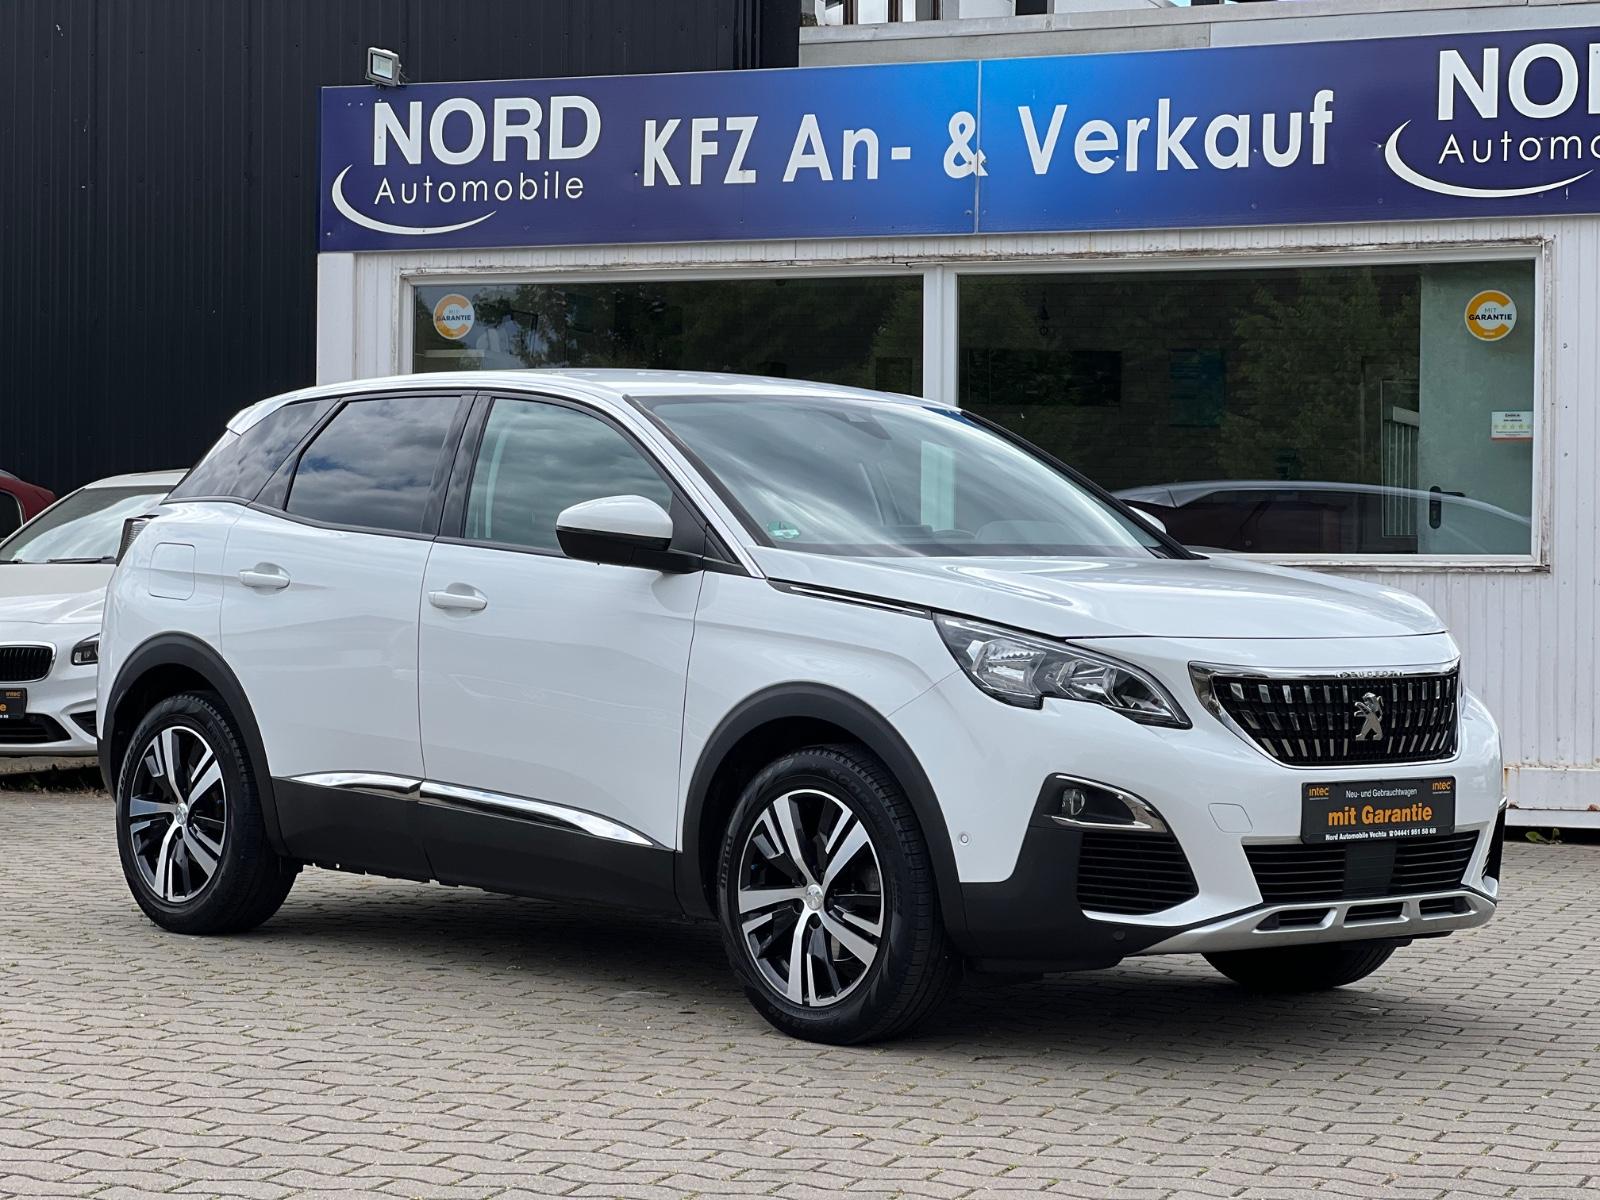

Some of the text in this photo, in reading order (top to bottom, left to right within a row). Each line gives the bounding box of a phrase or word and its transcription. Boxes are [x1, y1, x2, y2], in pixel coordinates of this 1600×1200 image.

[1437, 43, 1600, 121] NO
[373, 95, 601, 166] NORD
[643, 89, 1334, 187] KFZ An- & Verkauf
[374, 171, 584, 205] Automobile
[1468, 313, 1513, 321] GARANTIE
[1309, 787, 1329, 797] intec
[1345, 788, 1418, 798] Neu- und Gebrauchtwagen
[1432, 781, 1451, 791] intec
[1327, 802, 1433, 826] mit Garantie
[1325, 833, 1339, 841] Nord
[1339, 832, 1369, 840] Automobile
